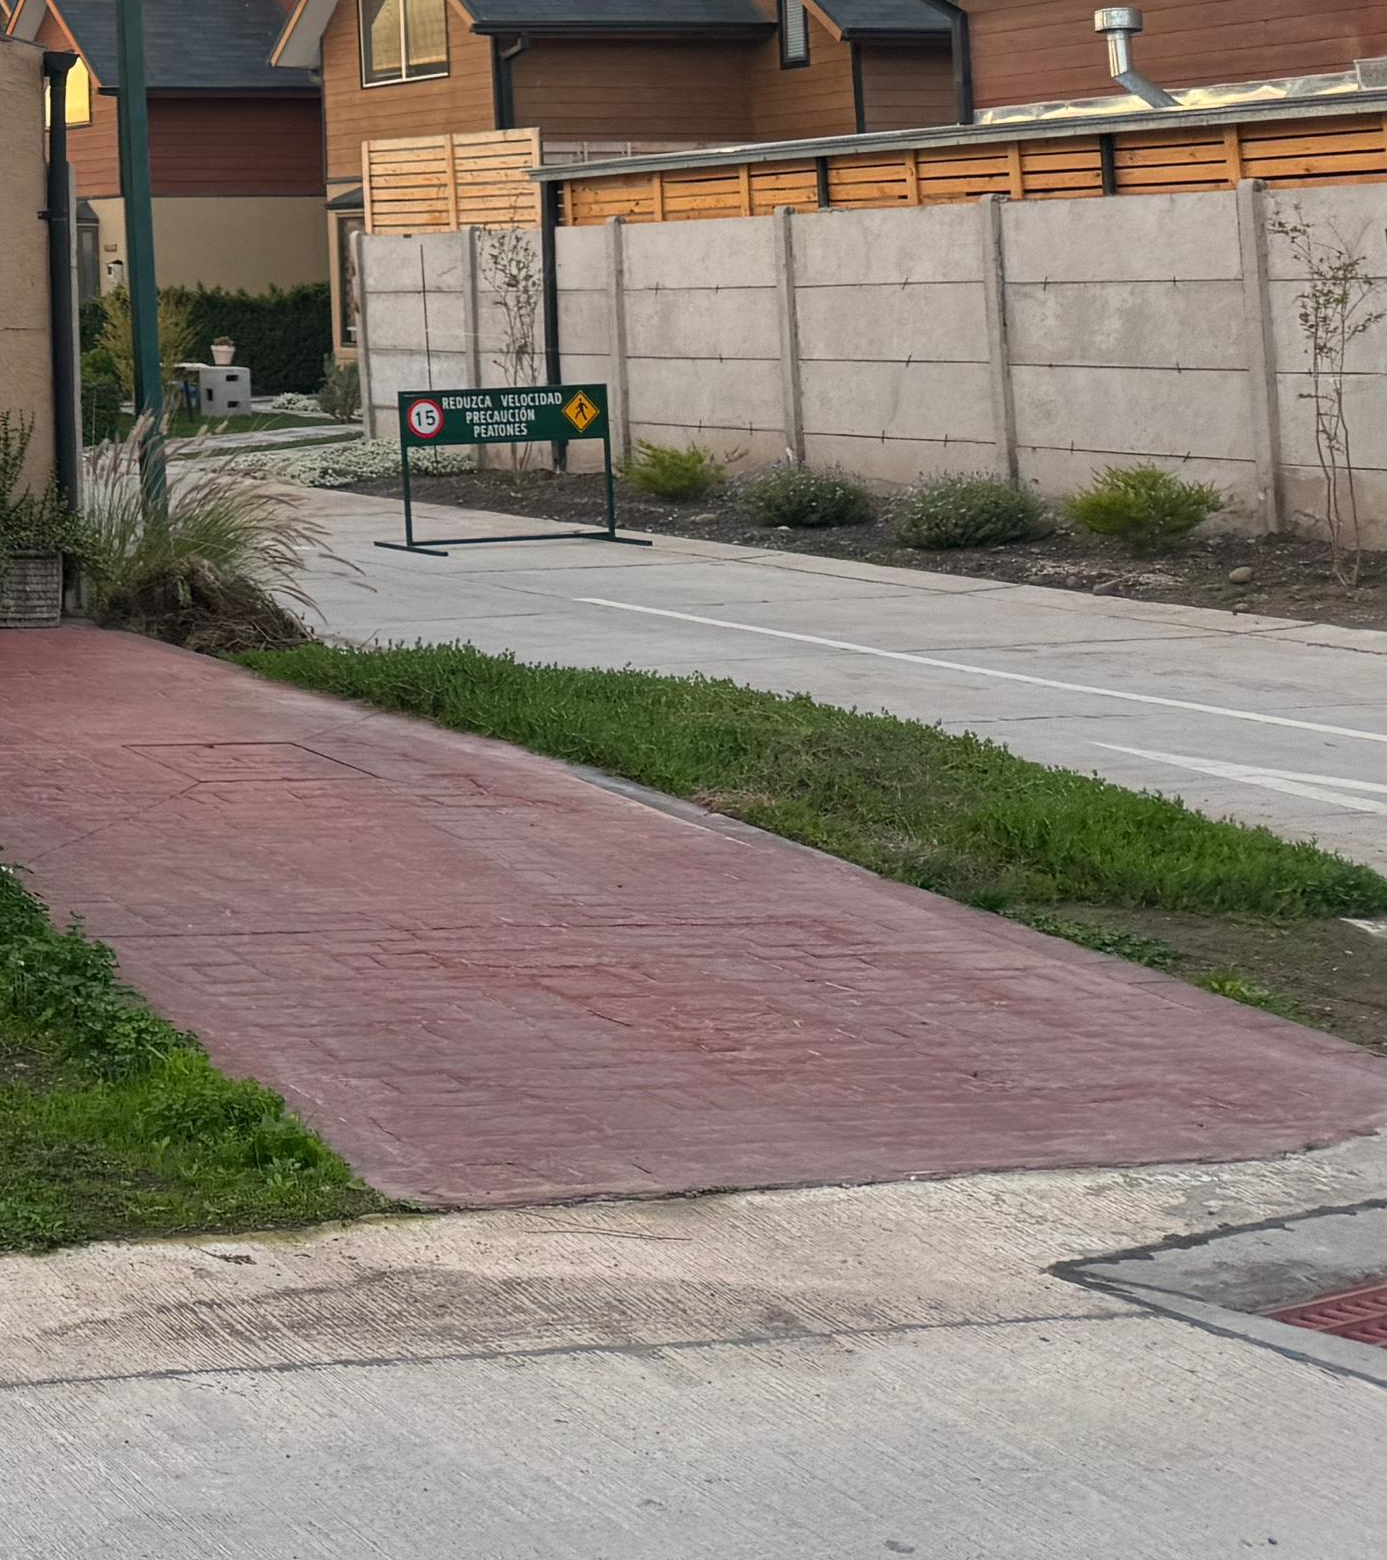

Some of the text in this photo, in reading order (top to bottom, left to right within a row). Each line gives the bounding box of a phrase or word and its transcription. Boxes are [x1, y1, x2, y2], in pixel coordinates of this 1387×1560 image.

[441, 392, 563, 409] REDUZCA VELOCIDAD
[414, 409, 437, 427] 15
[465, 407, 536, 425] PRECAUCIÓN
[473, 423, 529, 439] PEATONES
